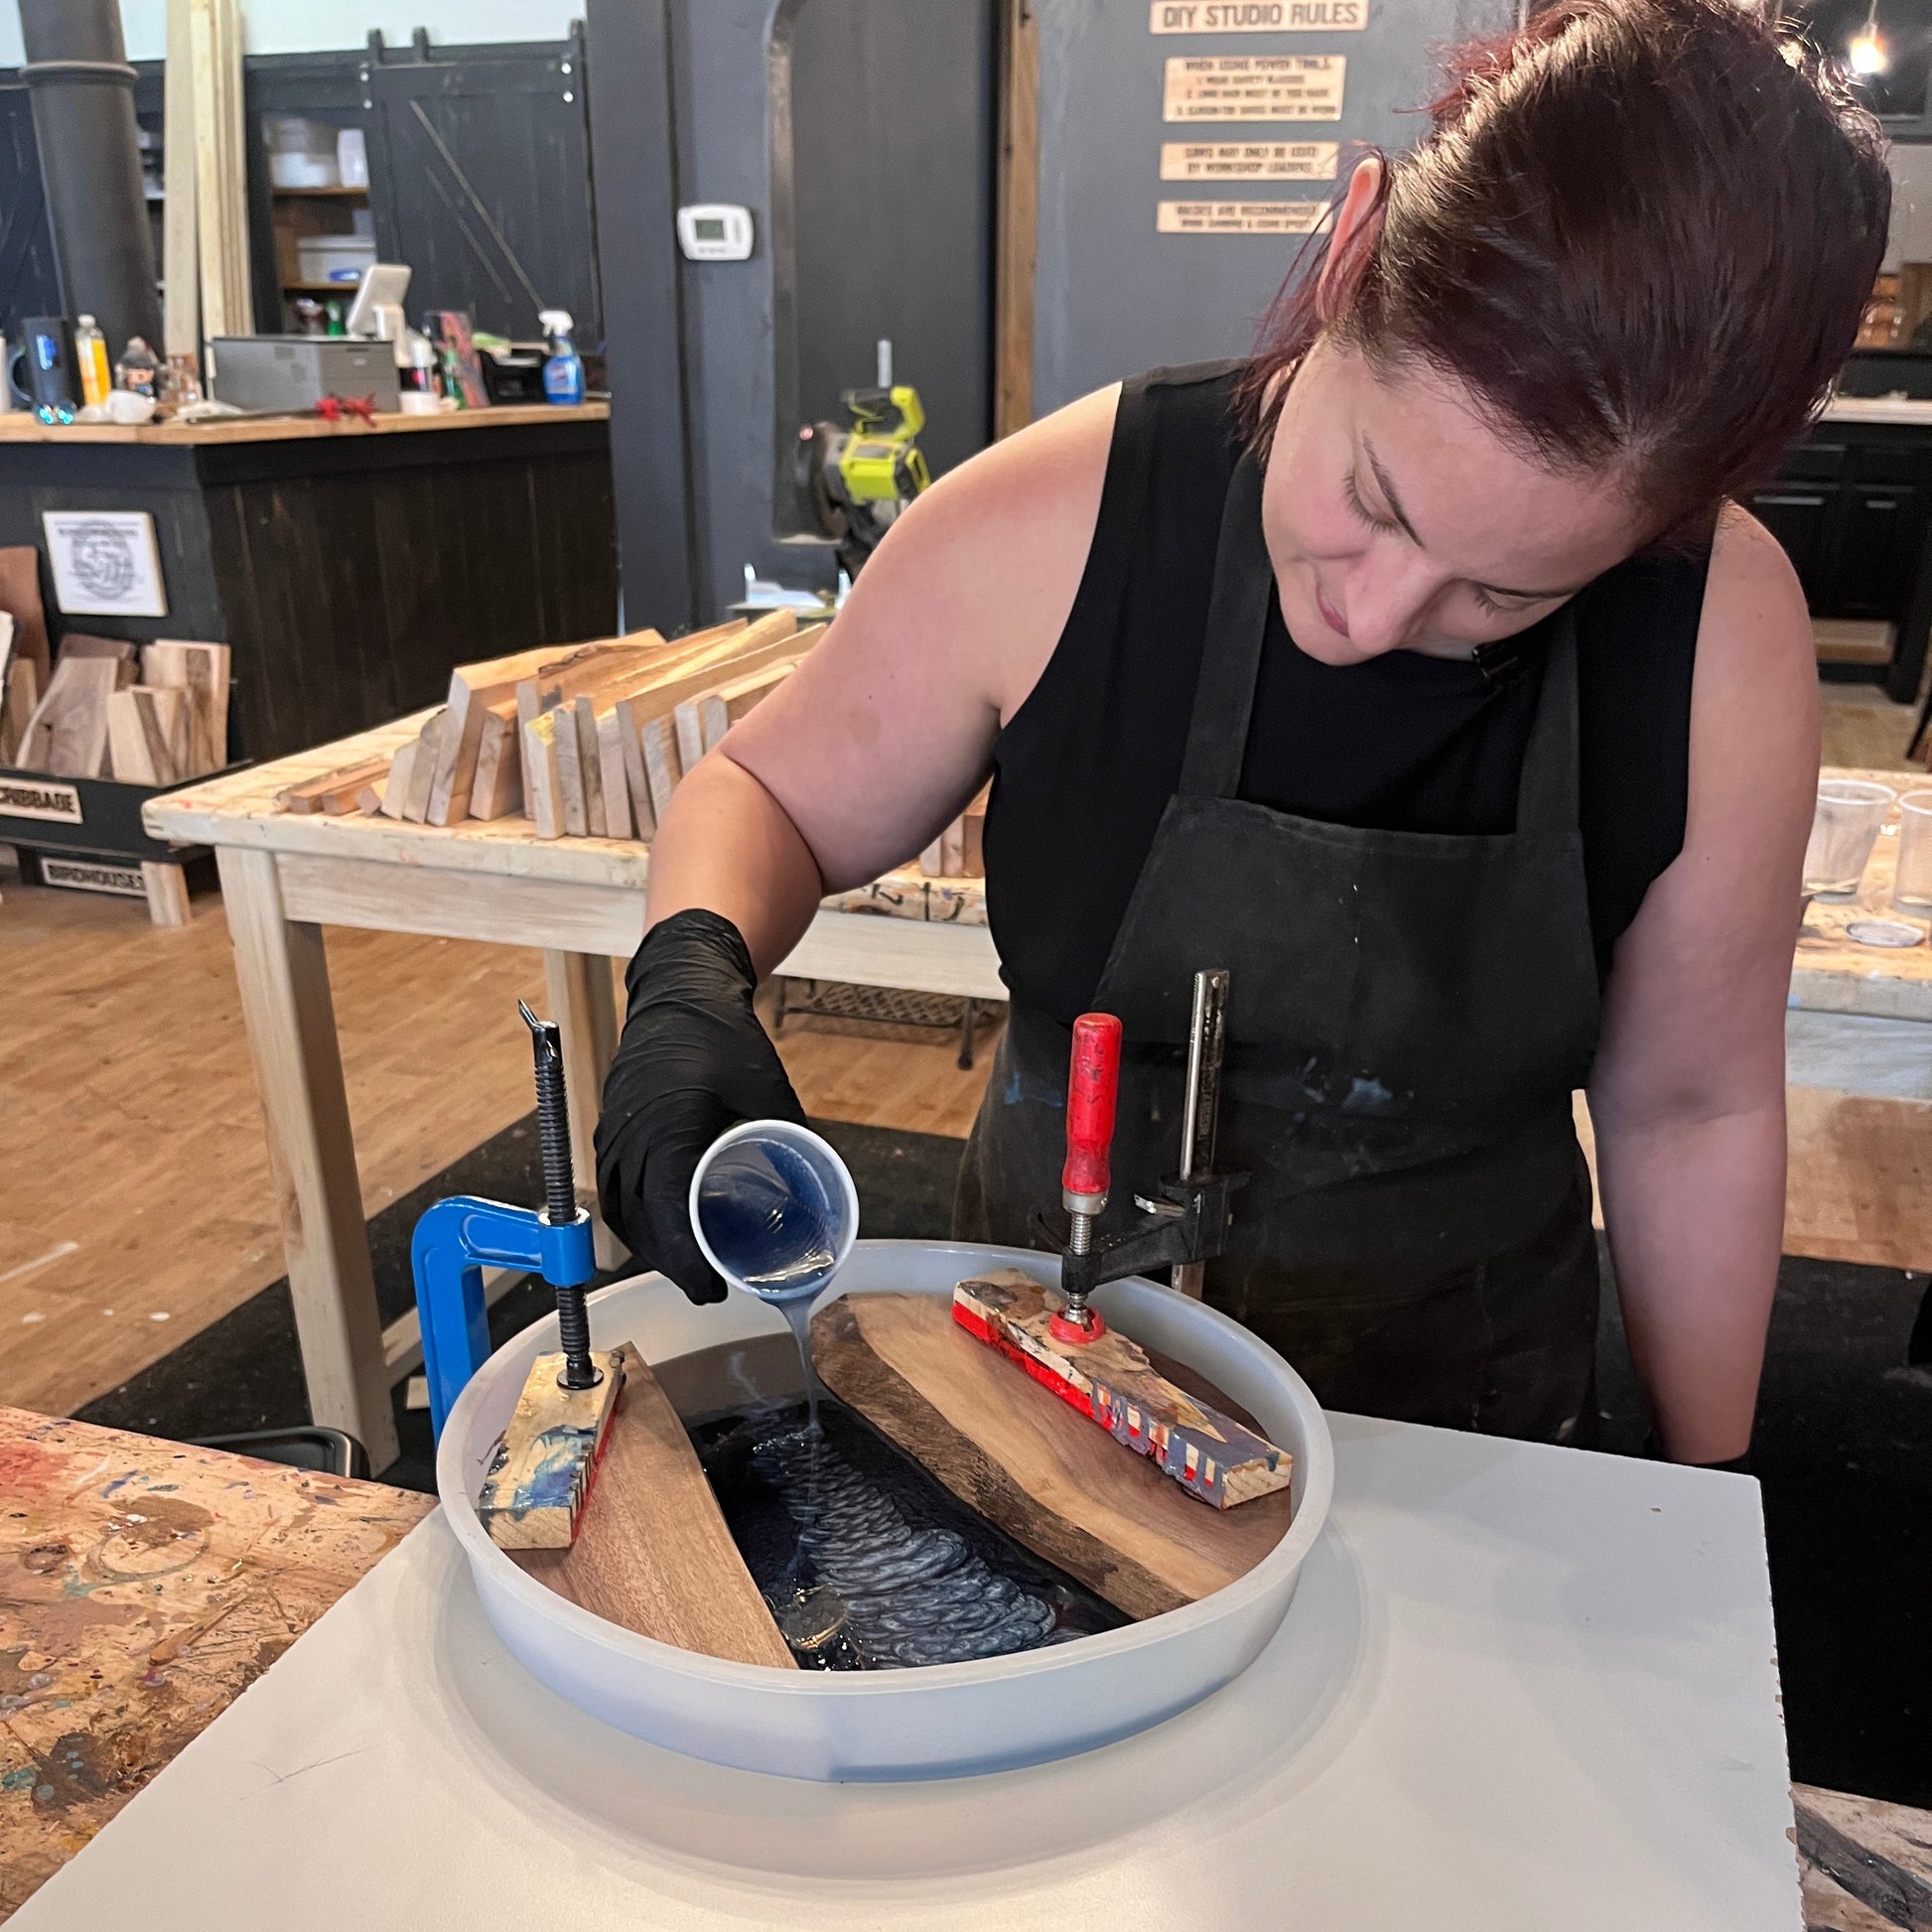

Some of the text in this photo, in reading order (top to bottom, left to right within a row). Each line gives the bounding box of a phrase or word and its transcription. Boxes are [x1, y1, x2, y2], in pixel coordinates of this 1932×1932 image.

[1164, 3, 1358, 28] DIY STUDIO RULES
